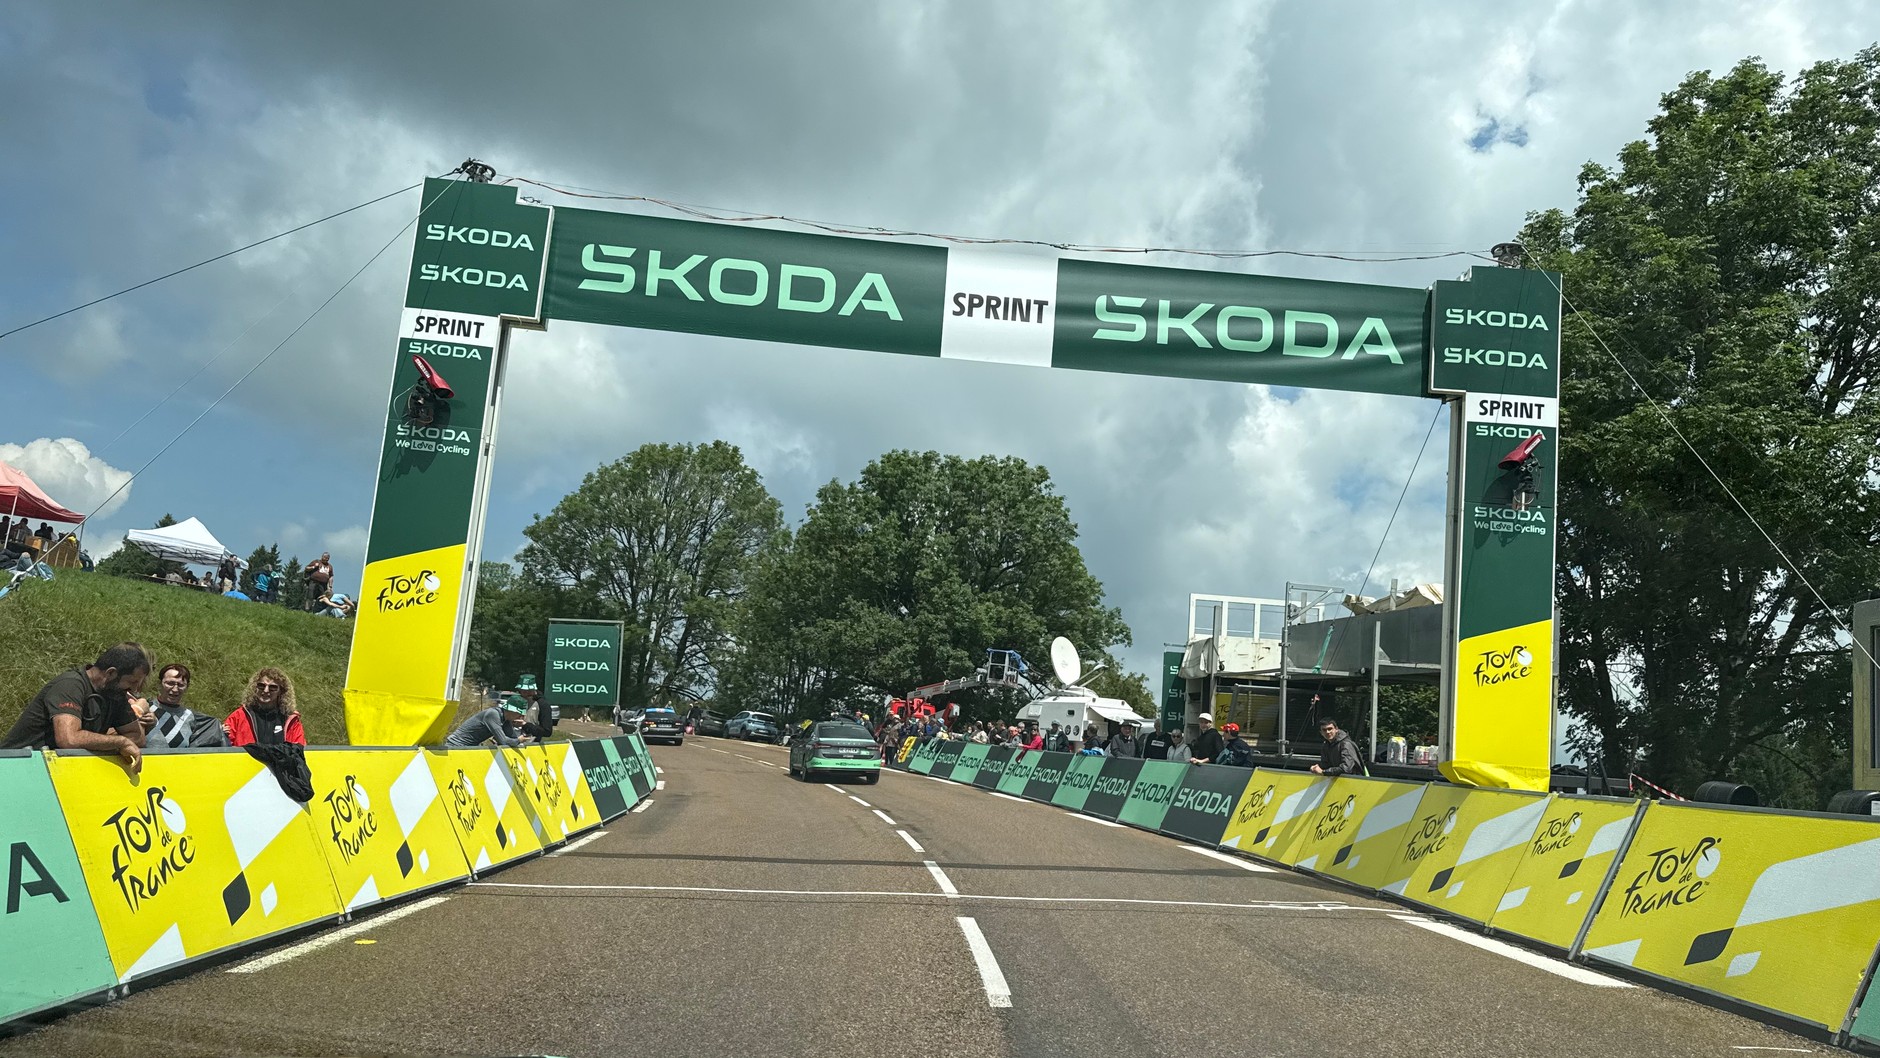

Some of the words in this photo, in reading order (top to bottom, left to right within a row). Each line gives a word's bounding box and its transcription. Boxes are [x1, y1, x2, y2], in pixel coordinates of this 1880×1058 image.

[952, 292, 1049, 324] SPRINT
[414, 315, 485, 339] SPRINT
[1478, 399, 1545, 420] SPRINT
[395, 438, 410, 448] We
[412, 440, 434, 450] Love
[436, 443, 470, 456] Cycling
[1473, 520, 1490, 530] We
[1491, 521, 1512, 532] Love
[1514, 524, 1547, 536] Cycling
[376, 587, 440, 614] france
[415, 587, 425, 595] de
[1473, 662, 1533, 688] france
[1509, 661, 1519, 669] de
[160, 826, 172, 848] de
[111, 836, 196, 915] france
[1678, 867, 1693, 885] de
[1620, 870, 1706, 919] france
